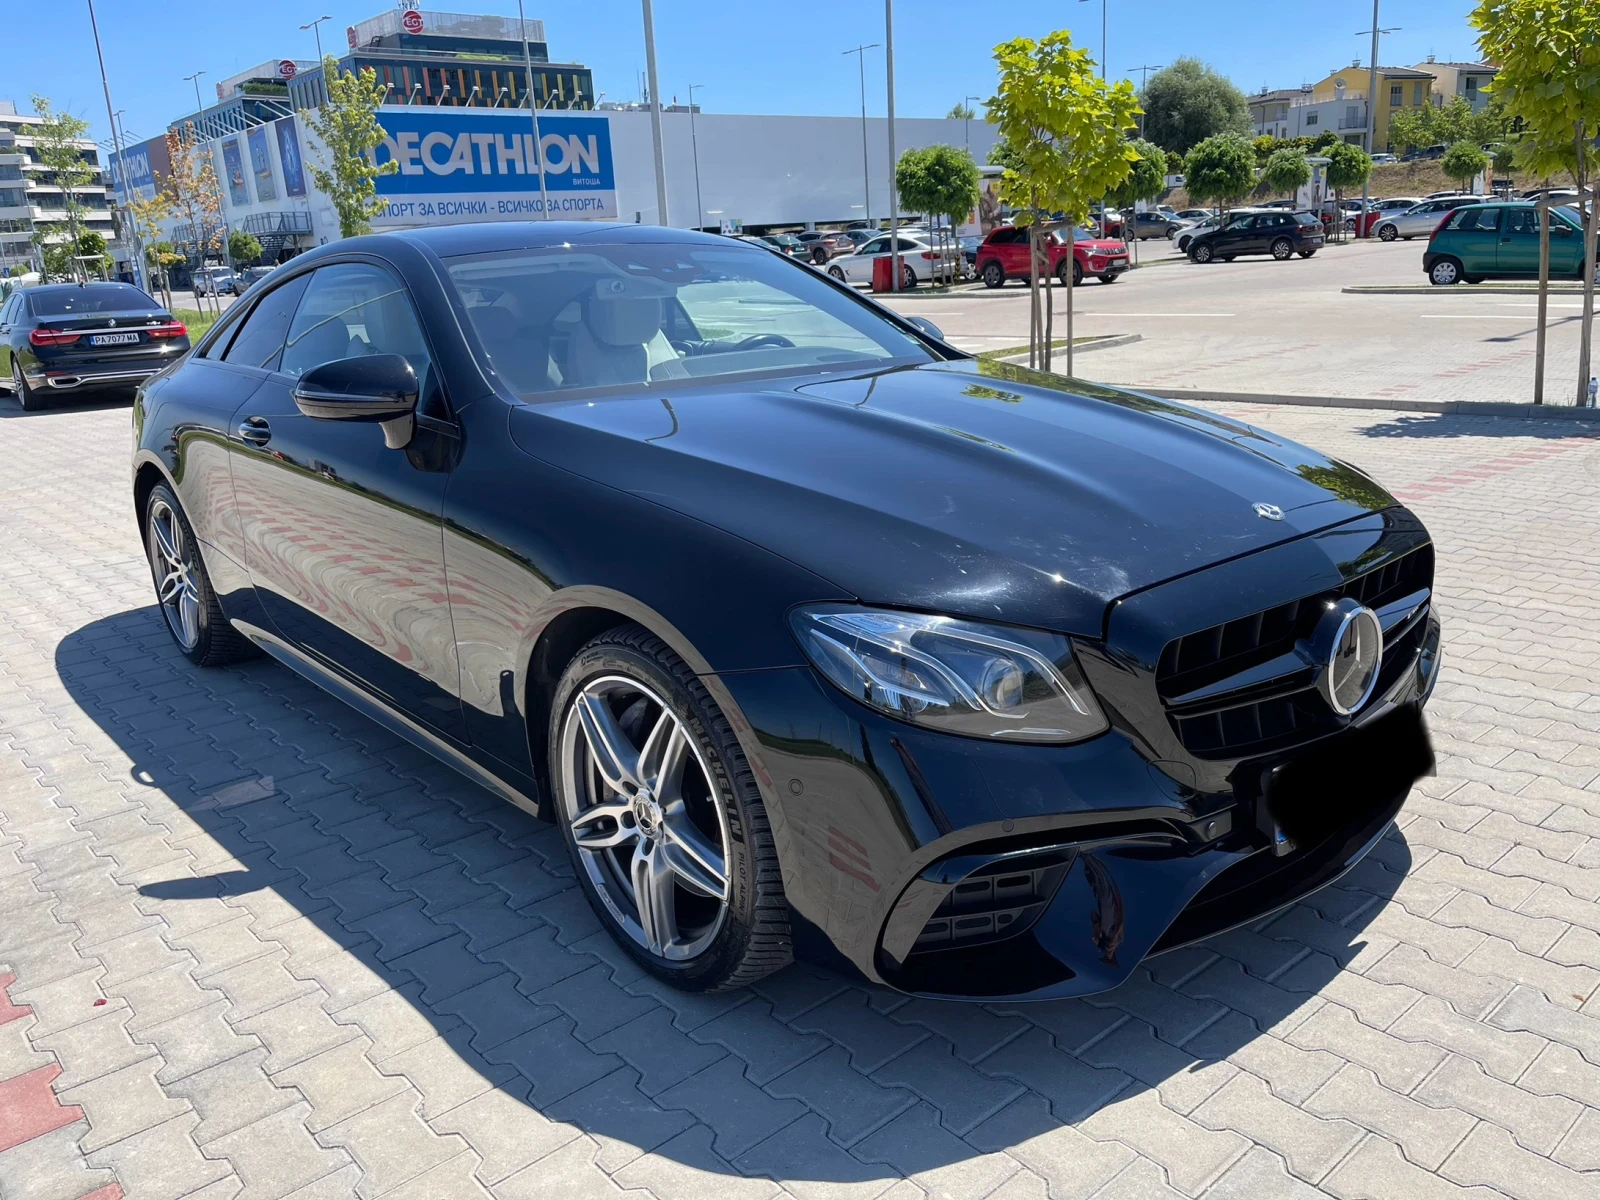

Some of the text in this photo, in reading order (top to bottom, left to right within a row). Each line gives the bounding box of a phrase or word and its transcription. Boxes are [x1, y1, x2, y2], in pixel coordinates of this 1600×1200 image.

[406, 17, 423, 27] EGT
[364, 131, 600, 176] DECATHLON
[572, 178, 601, 186] ВИТОША
[377, 202, 415, 218] ПОРТ
[418, 202, 436, 217] ЗА
[437, 201, 488, 217] ВСИЧКИ
[498, 199, 544, 214] ВСИЧКО
[547, 199, 561, 212] ЗА
[562, 198, 604, 212] СПОРТА
[690, 717, 743, 837] MICHELIN
[738, 851, 747, 881] PILOT
